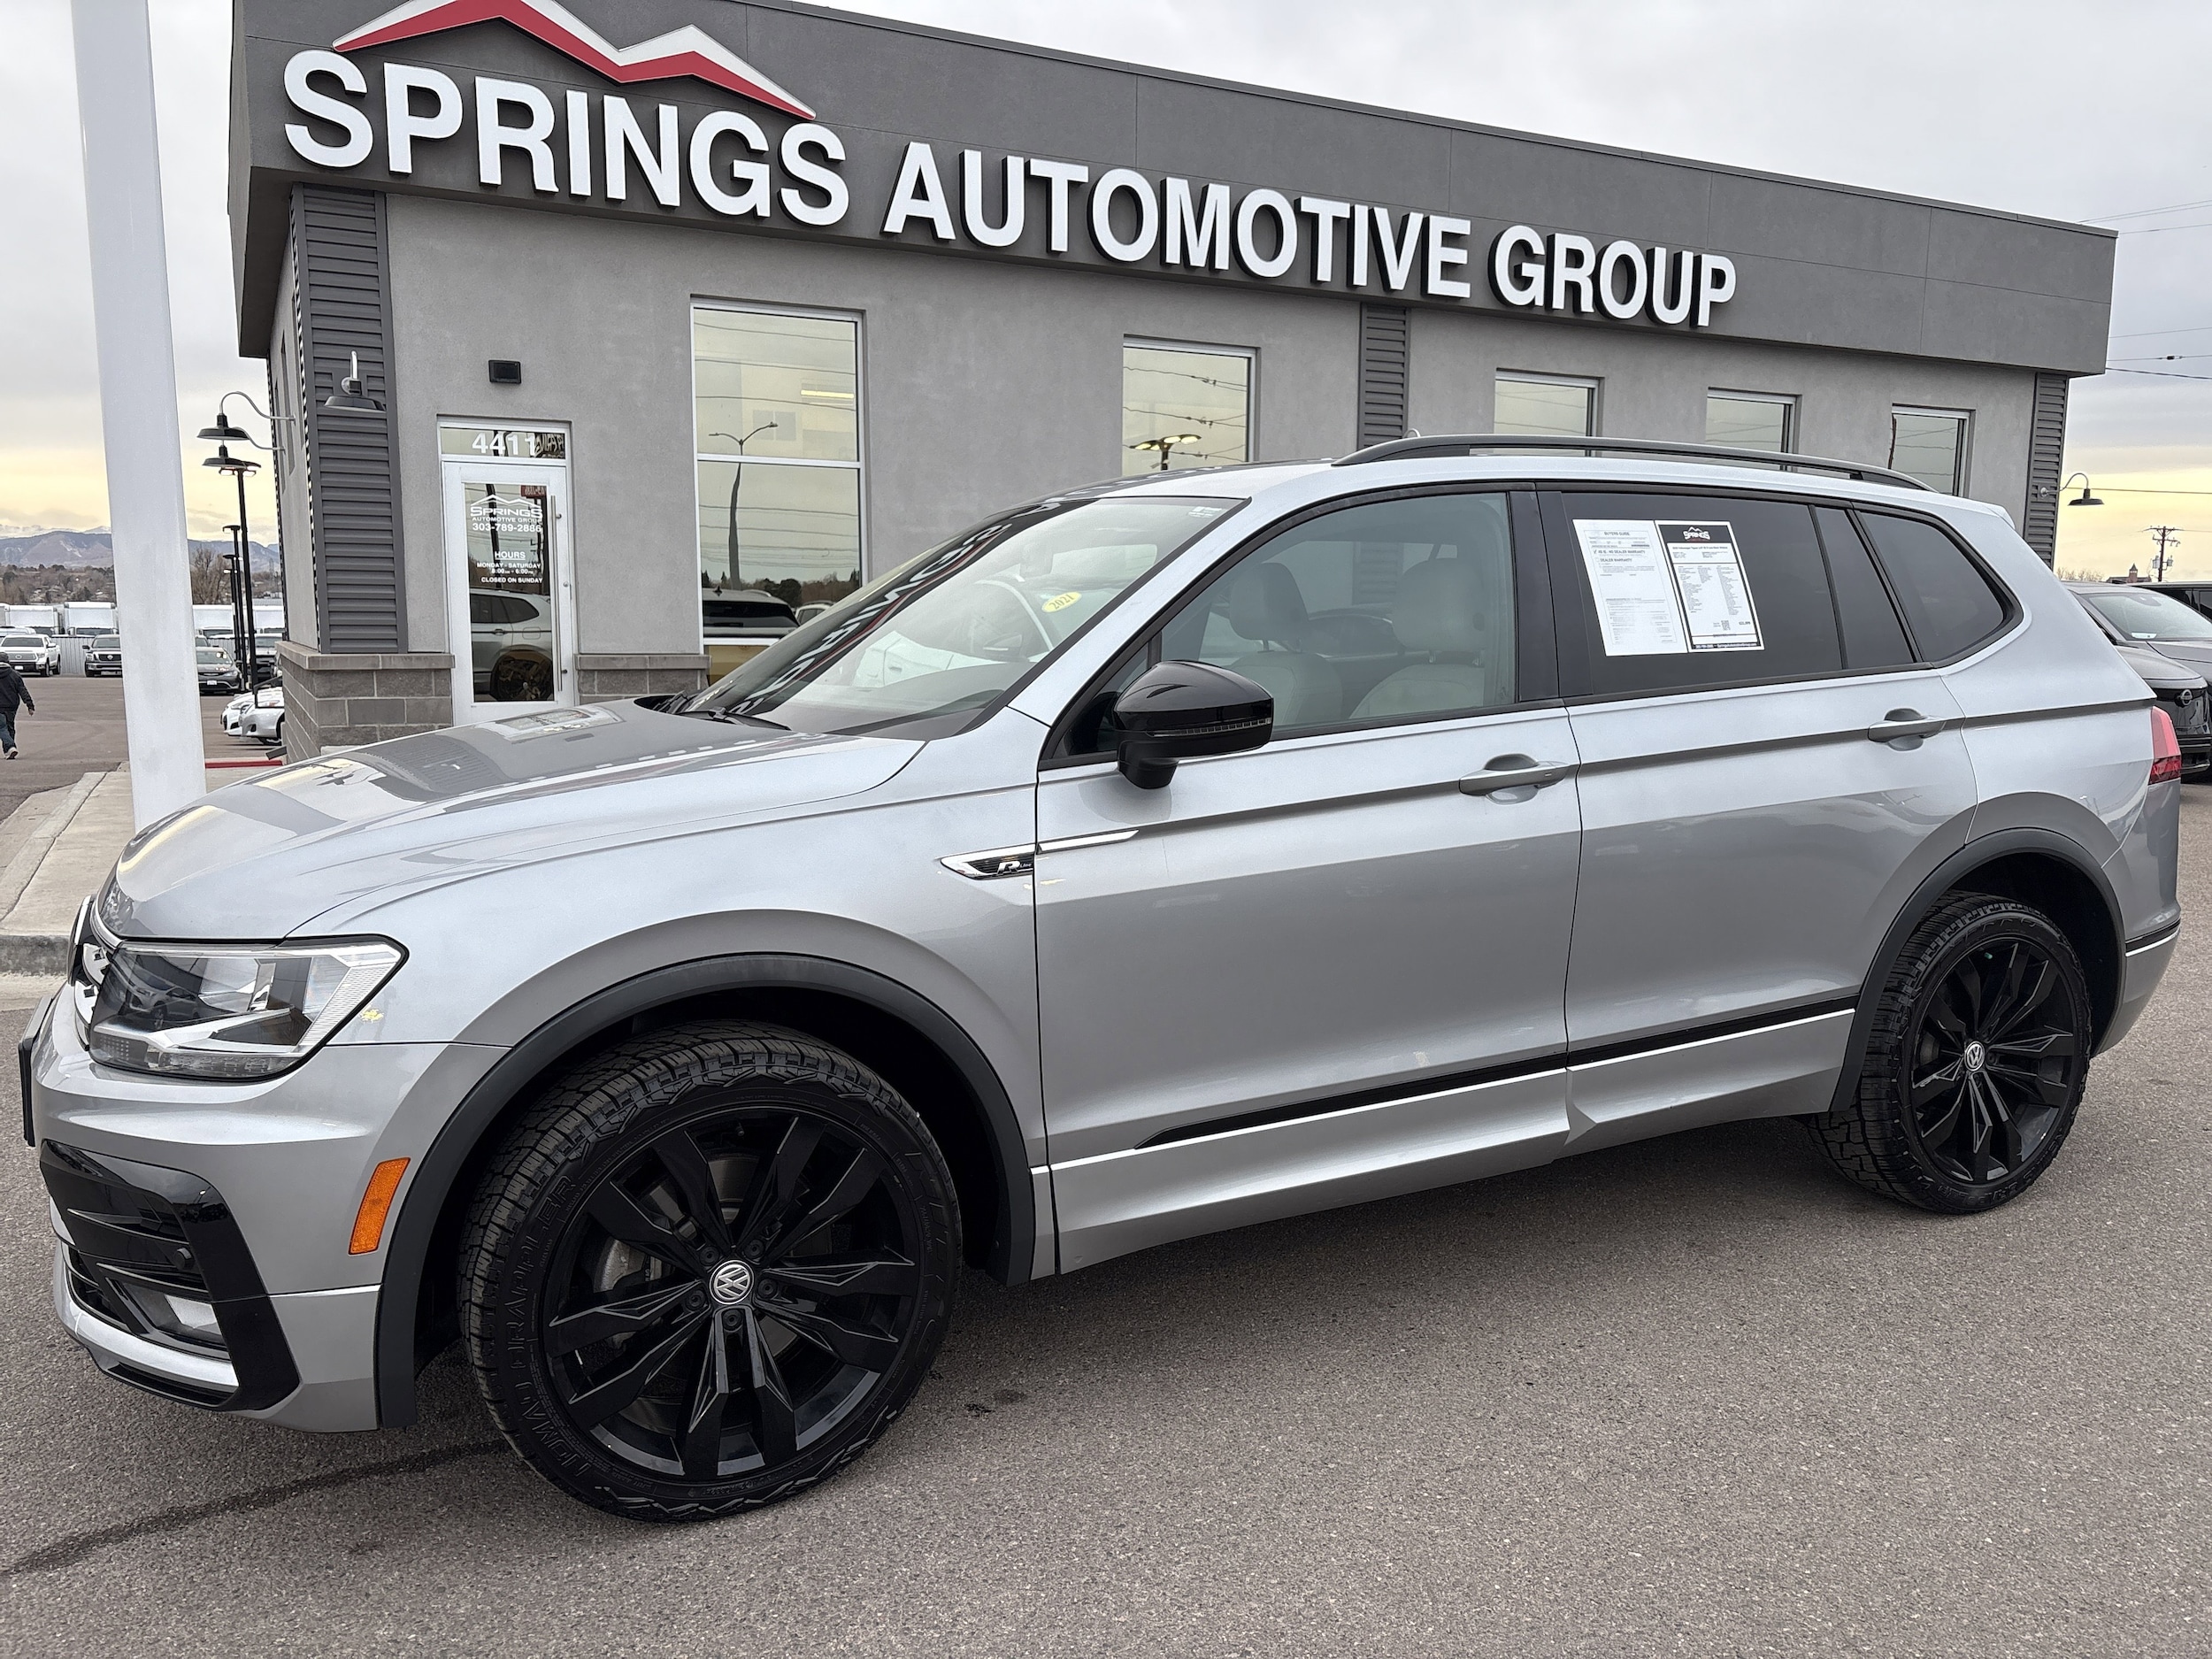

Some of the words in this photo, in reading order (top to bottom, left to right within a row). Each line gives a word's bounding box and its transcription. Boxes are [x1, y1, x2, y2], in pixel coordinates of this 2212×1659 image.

[283, 50, 849, 227] SPRINGS
[883, 141, 1471, 299] AUTOMOTIVE
[1494, 225, 1737, 326] GROUP
[472, 432, 535, 457] 4411
[470, 506, 543, 519] SPRINGS
[472, 523, 541, 533] 303-789-2886
[1048, 594, 1075, 610] 2021
